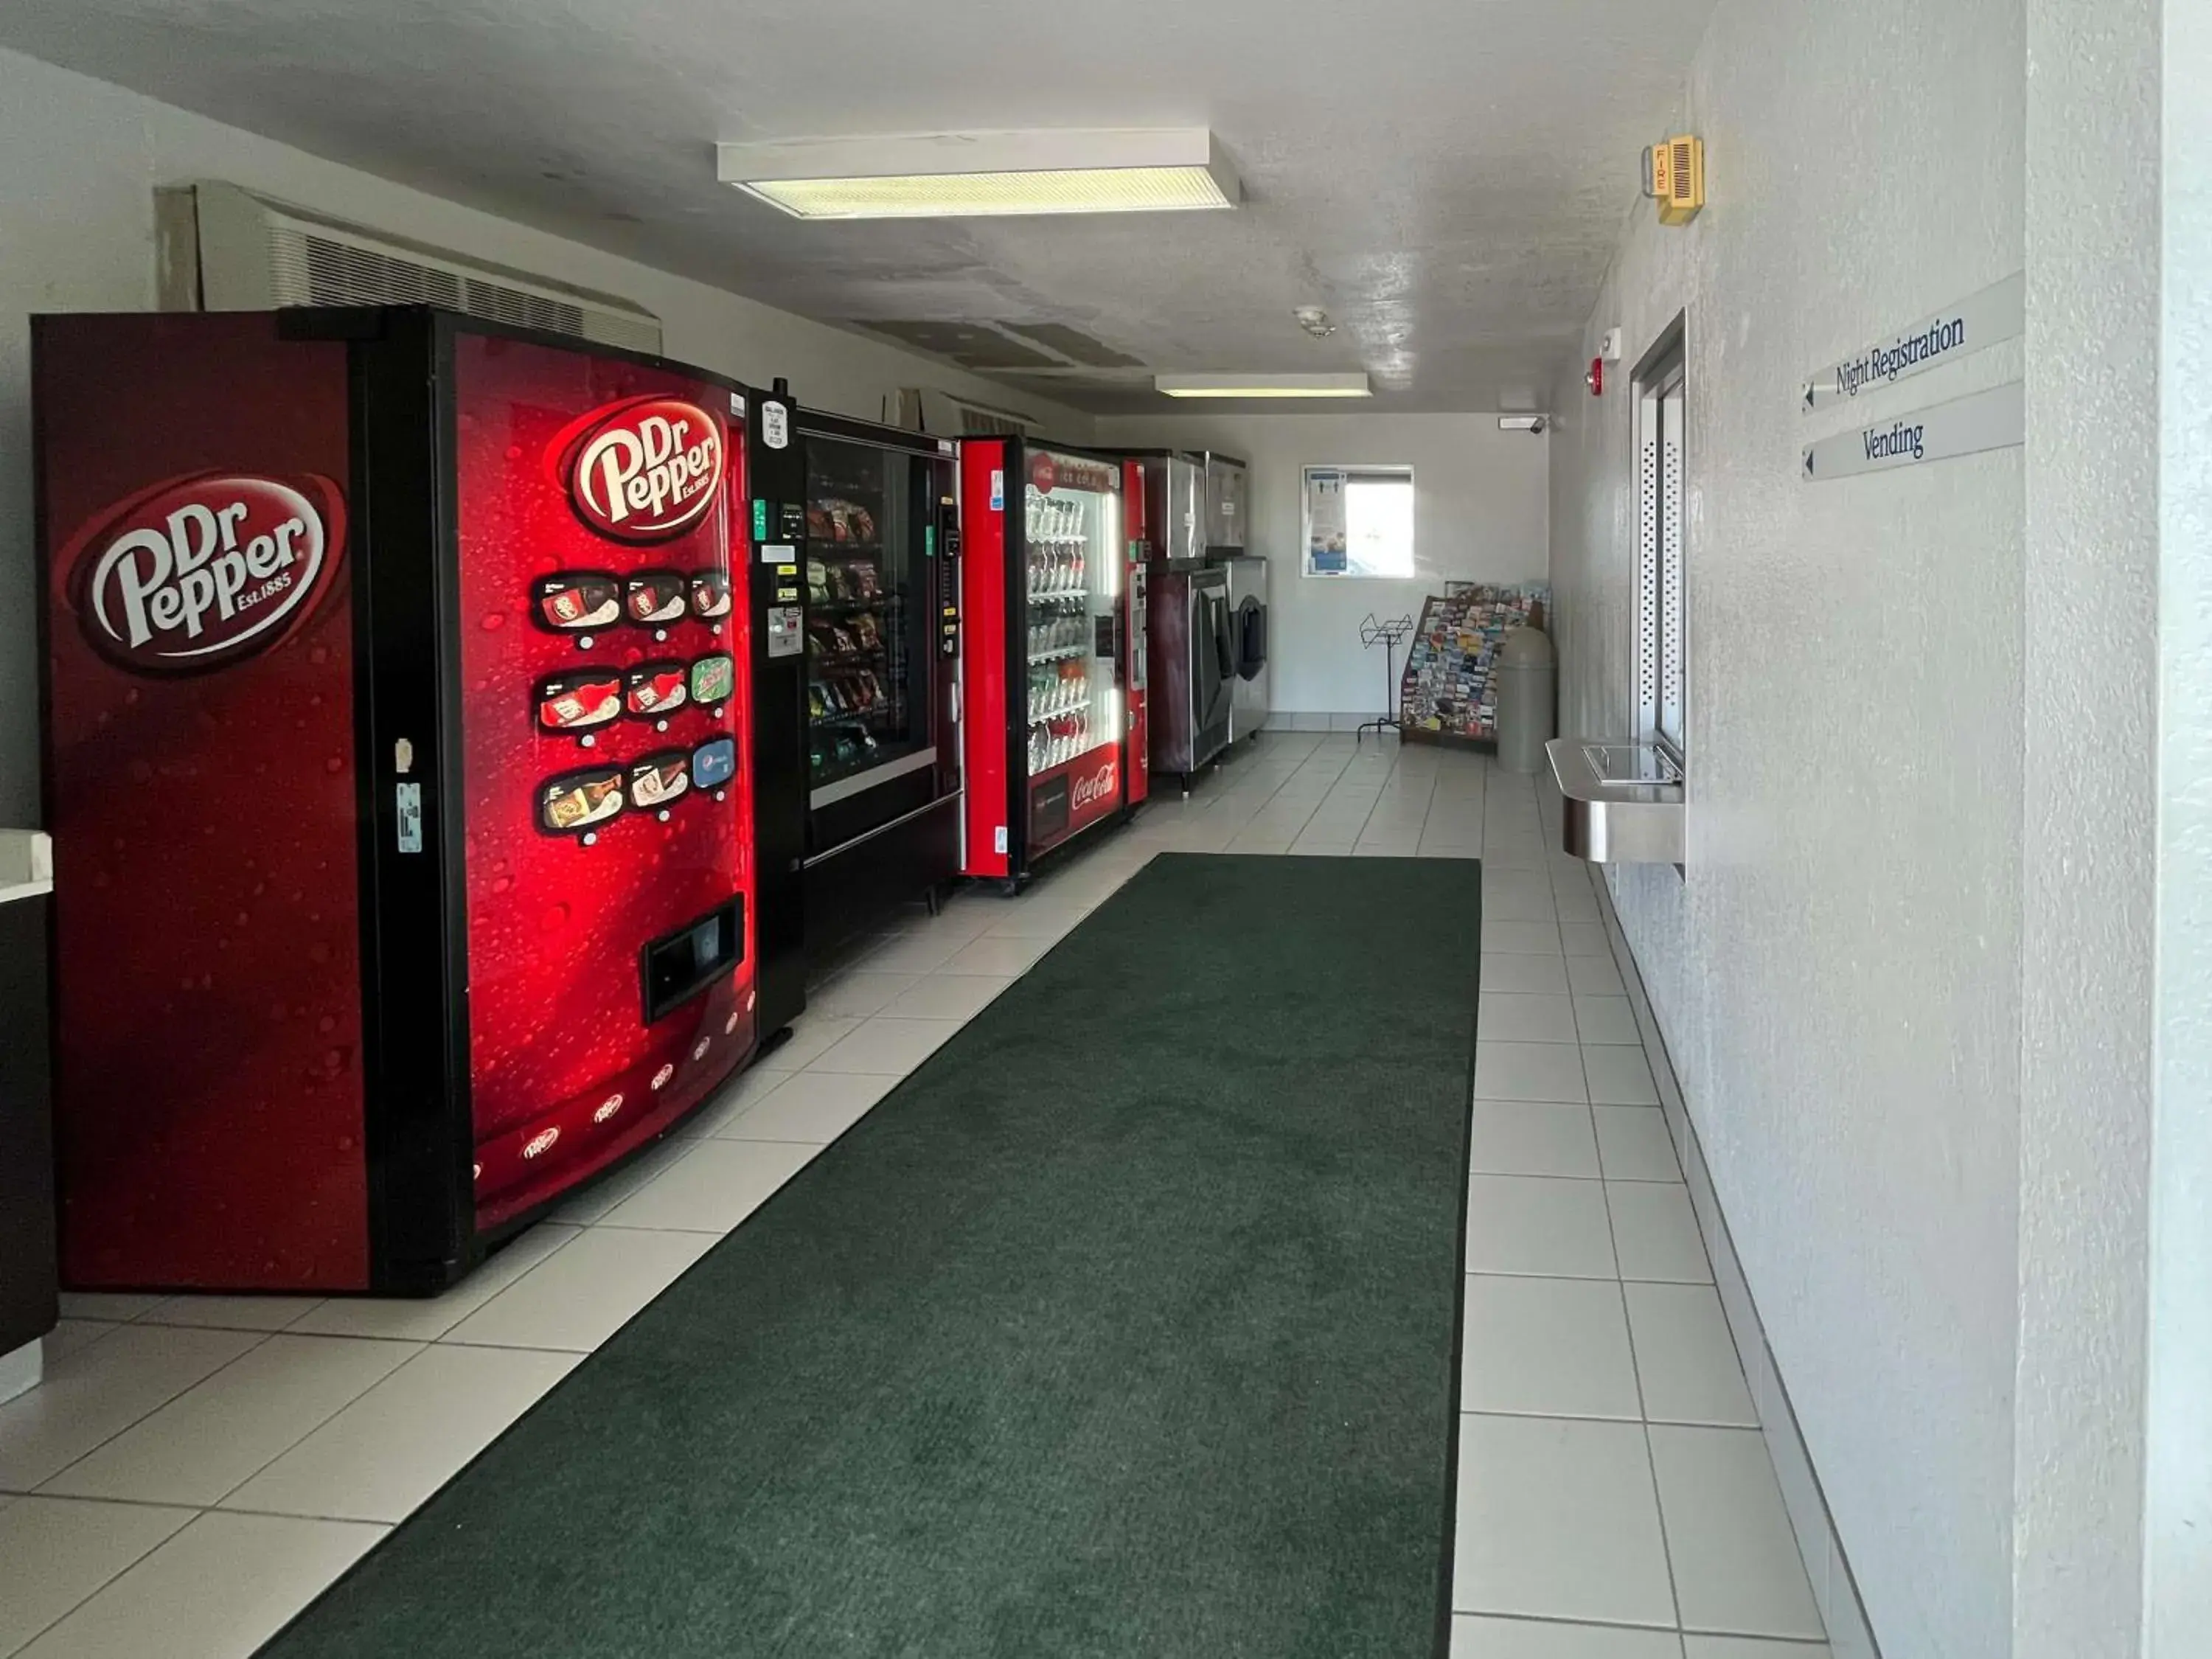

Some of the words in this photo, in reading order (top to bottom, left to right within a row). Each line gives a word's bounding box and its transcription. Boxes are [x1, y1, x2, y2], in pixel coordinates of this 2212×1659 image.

[1657, 150, 1665, 189] FIRE
[1836, 357, 1871, 396] Night
[1871, 318, 1965, 380] Registration
[580, 428, 714, 523] Pepper
[639, 416, 689, 470] Dr
[1863, 422, 1924, 459] Vending
[166, 501, 247, 576] Dr
[93, 517, 305, 649] Pepper
